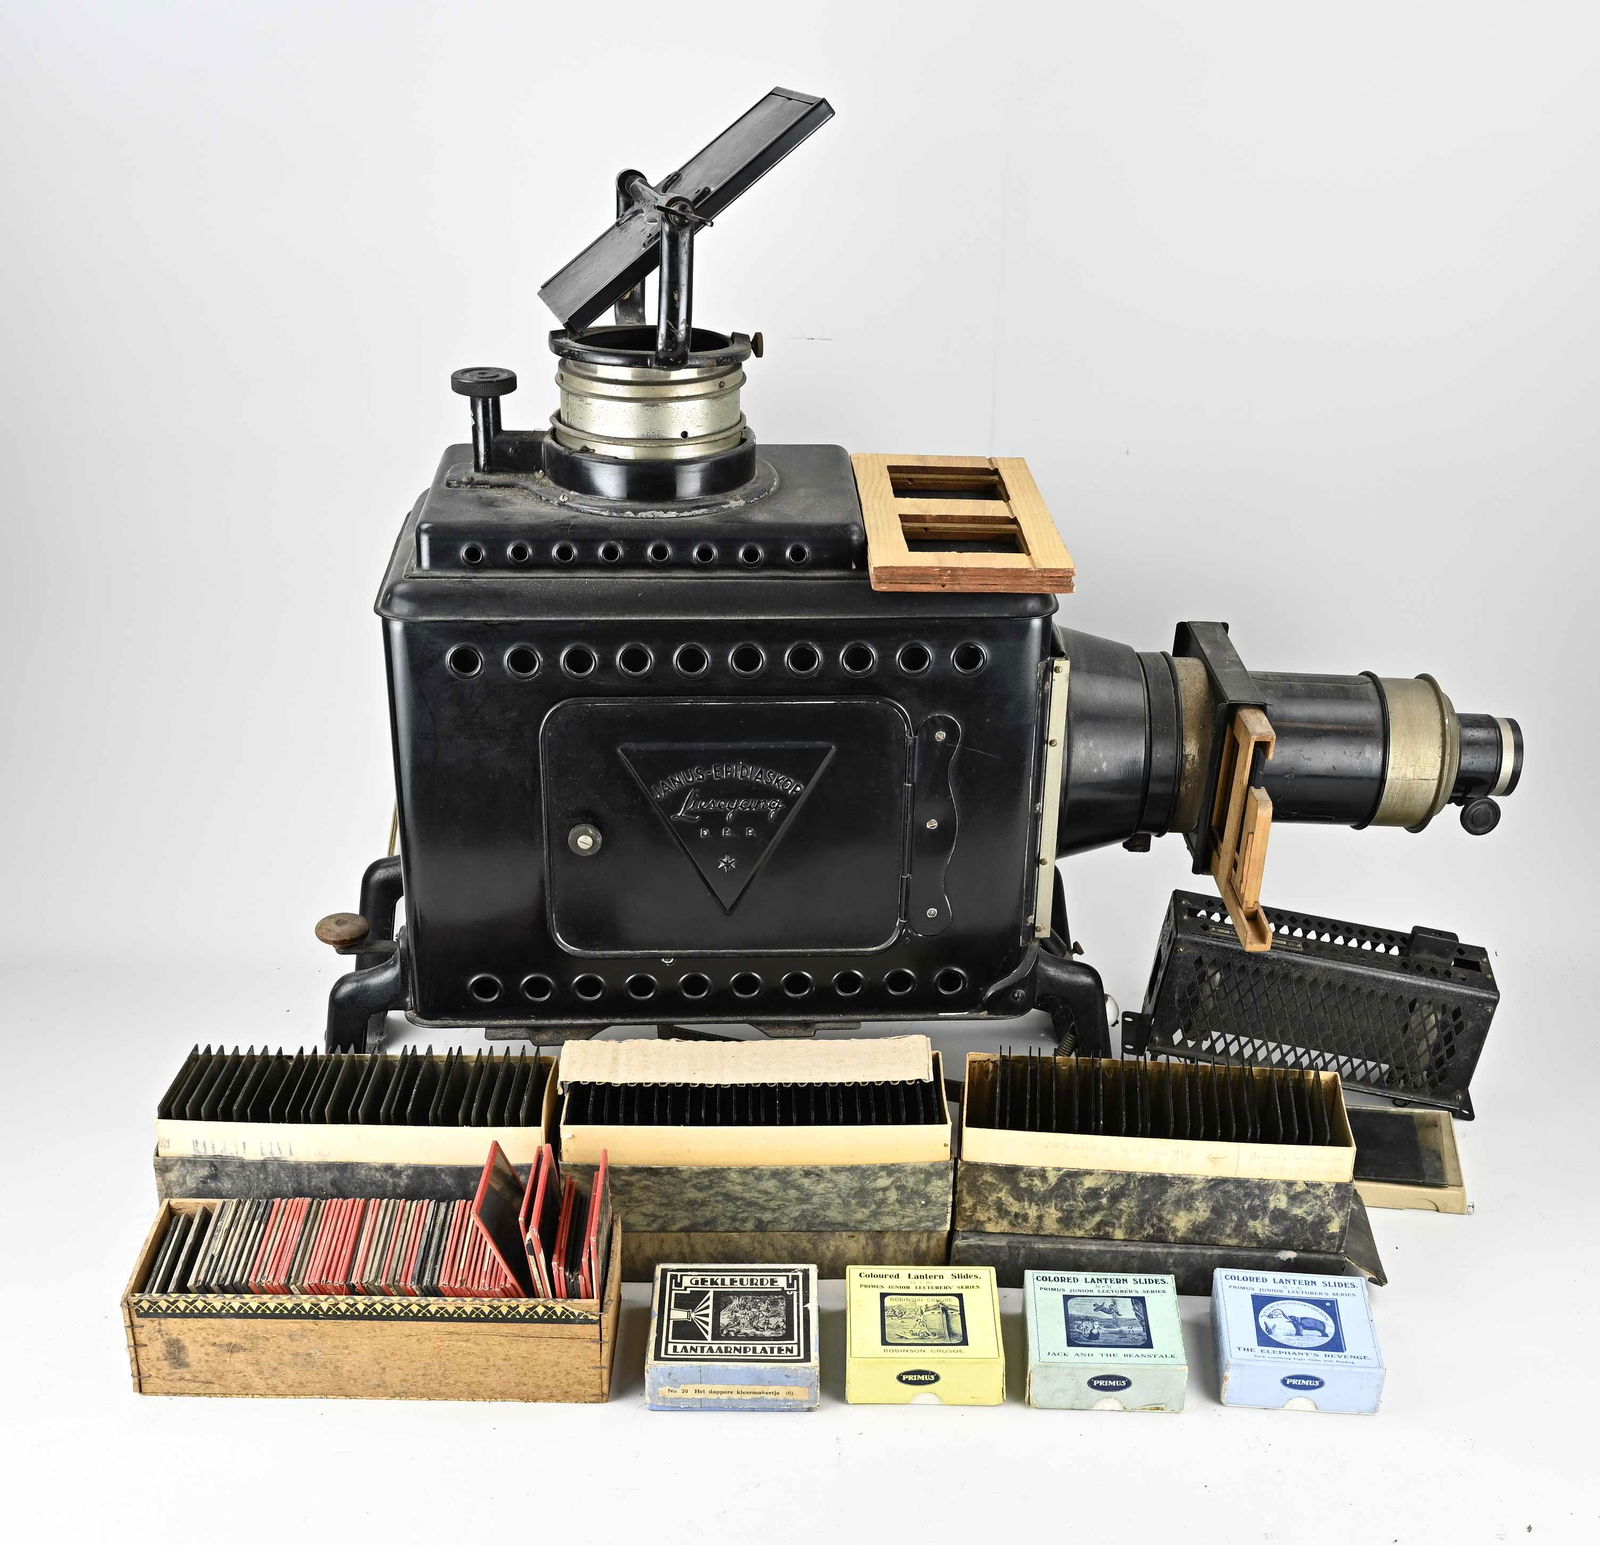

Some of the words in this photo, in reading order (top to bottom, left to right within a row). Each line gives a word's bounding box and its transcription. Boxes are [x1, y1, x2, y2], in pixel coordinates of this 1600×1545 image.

[858, 1271, 900, 1280] Coloured
[907, 1272, 945, 1280] Lantern
[951, 1272, 982, 1280] Slides.
[1035, 1275, 1079, 1283] COLORED
[1084, 1277, 1128, 1285] LANTERN
[689, 1277, 780, 1287] GEKLEURDE
[1224, 1274, 1268, 1283] COLORED
[1272, 1278, 1317, 1287] LANTERN
[1322, 1281, 1359, 1289] SLIDES.
[672, 1345, 794, 1355] LANTAARNPLATEN
[1260, 1349, 1319, 1358] ELEPHANT'S
[708, 1389, 734, 1397] dappere
